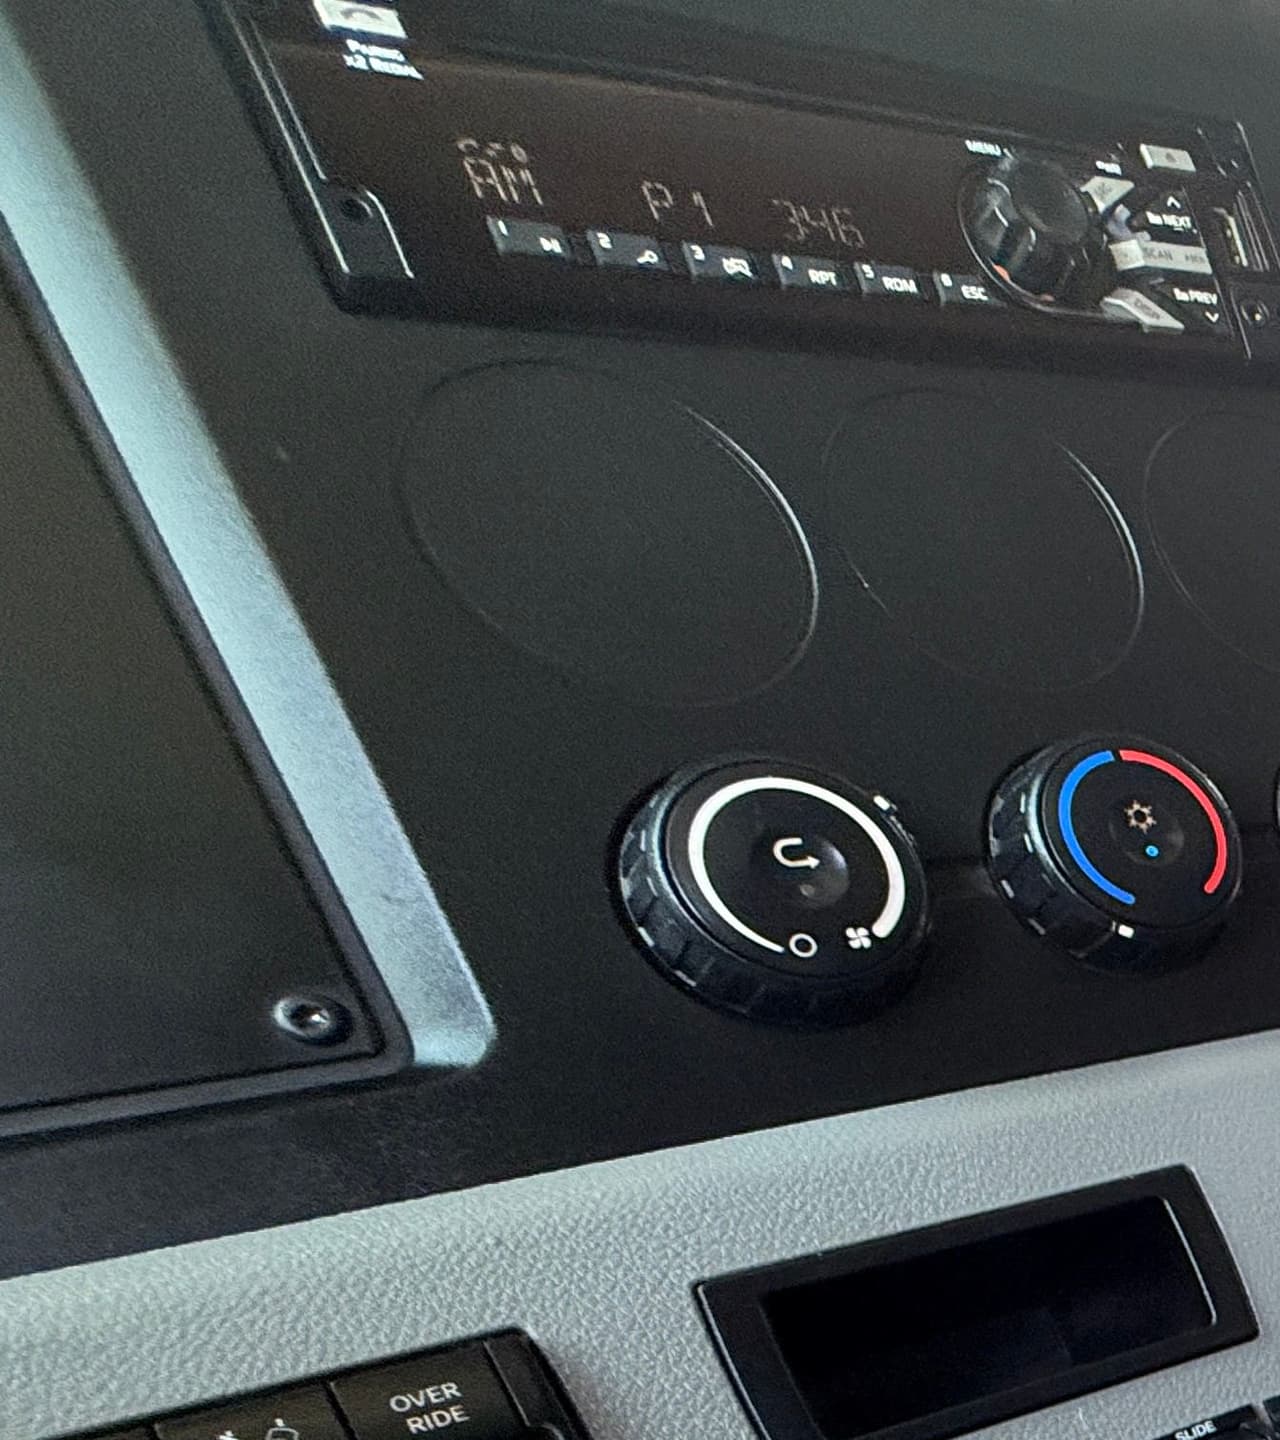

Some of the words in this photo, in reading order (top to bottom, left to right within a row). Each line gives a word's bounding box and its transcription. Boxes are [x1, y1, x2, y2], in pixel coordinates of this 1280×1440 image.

[462, 156, 544, 205] AM
[808, 268, 837, 286] RPT
[961, 284, 989, 301] ESC
[389, 1382, 462, 1412] OVER
[406, 1404, 471, 1434] RIDE
